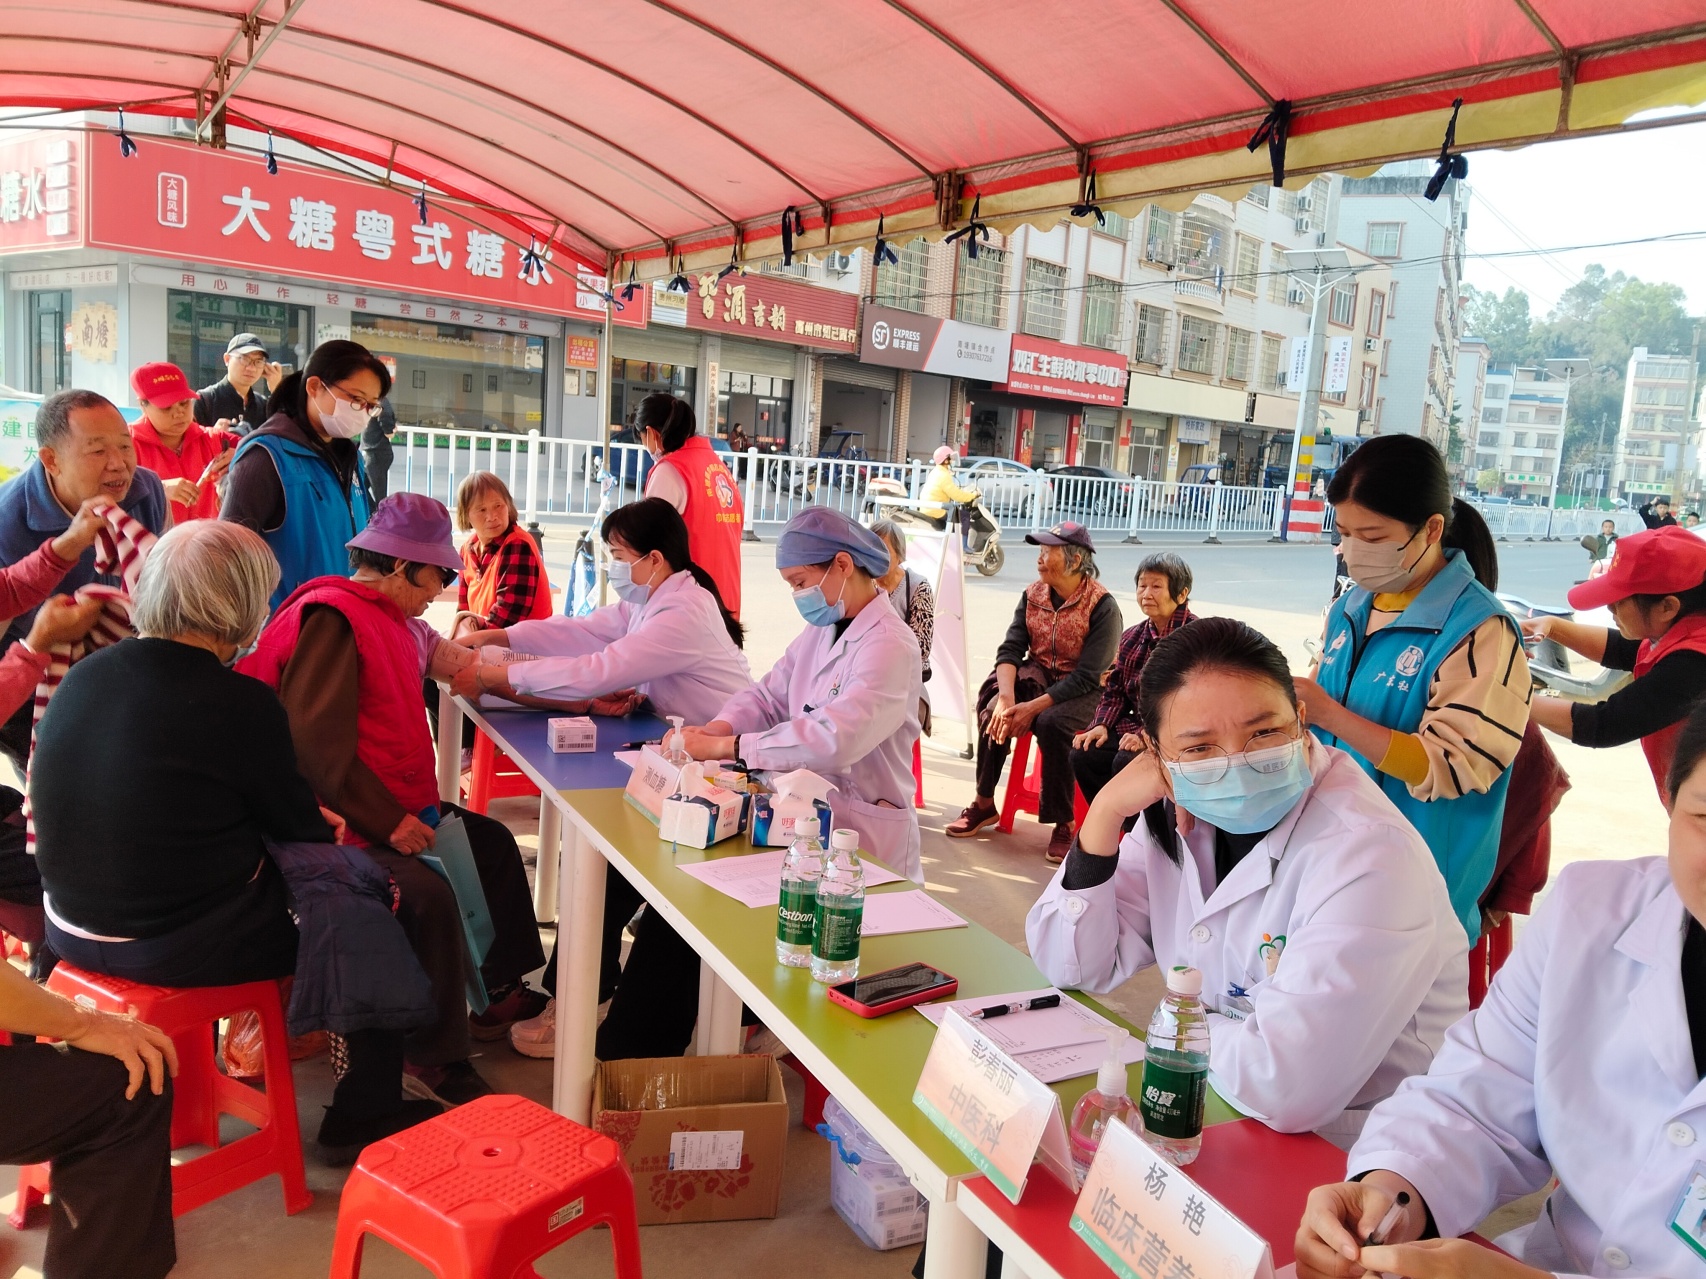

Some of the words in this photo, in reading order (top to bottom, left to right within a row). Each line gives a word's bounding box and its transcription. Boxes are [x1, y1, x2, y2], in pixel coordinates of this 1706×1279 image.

[1, 167, 46, 223] 糖水
[167, 178, 178, 222] 大糖风味
[221, 186, 554, 286] 大糖粤式糖水
[181, 273, 290, 299] 用心制作
[400, 303, 529, 330] 尝自然之本味
[893, 328, 920, 341] EXPRESS
[969, 1038, 1018, 1096] 彭春丽
[949, 1082, 1005, 1154] 中医科
